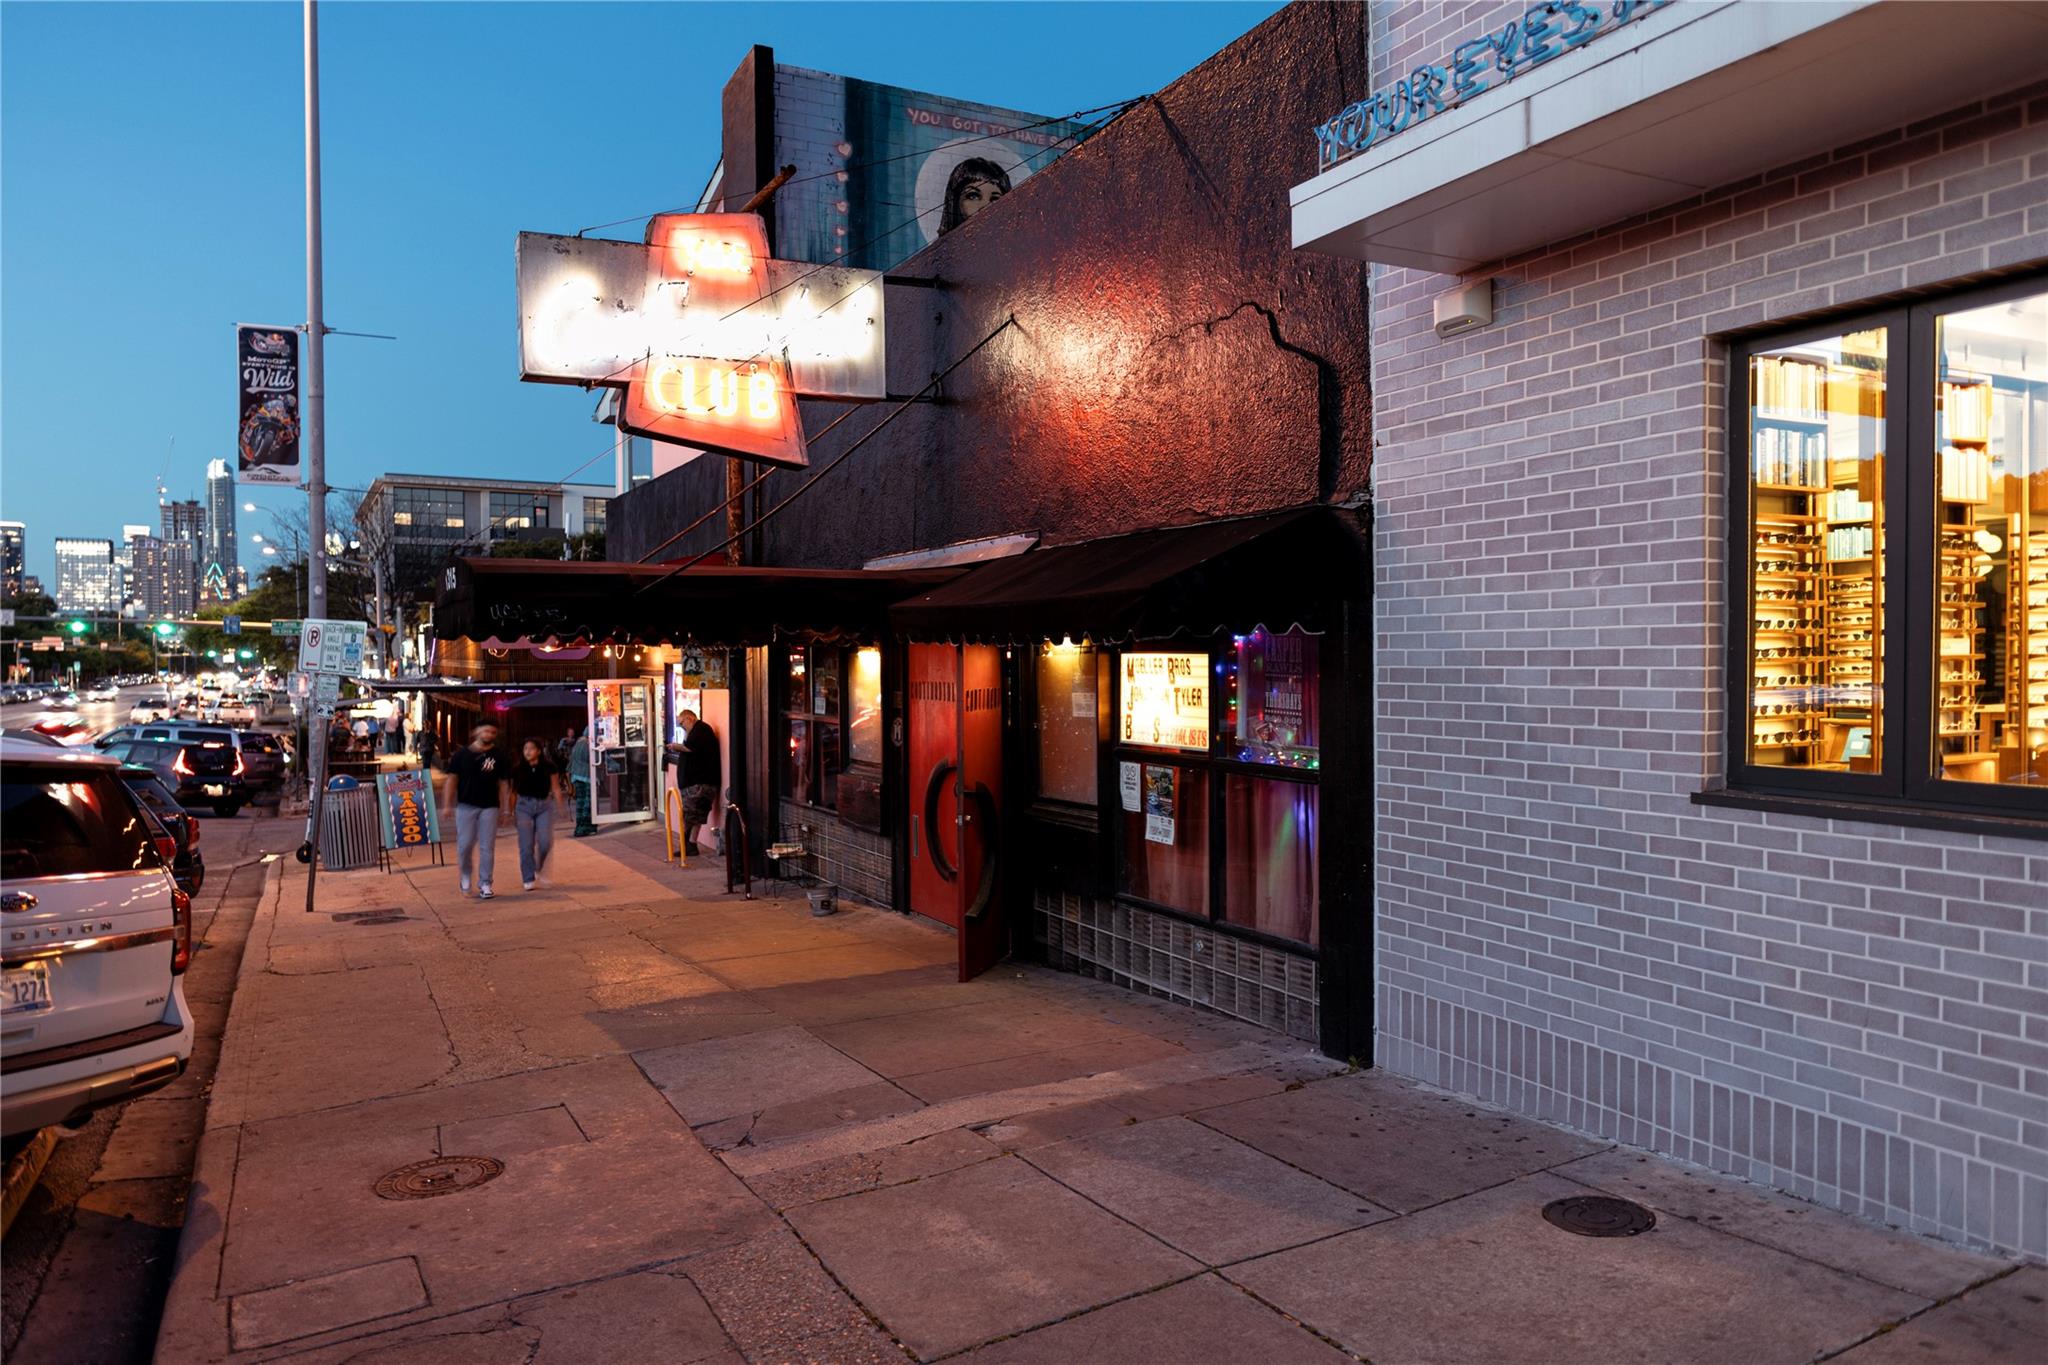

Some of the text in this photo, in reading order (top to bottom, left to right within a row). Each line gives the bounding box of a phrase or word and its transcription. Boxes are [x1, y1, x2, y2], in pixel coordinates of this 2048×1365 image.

[1314, 0, 1603, 163] YOUR EYES
[907, 107, 941, 125] YOU
[952, 117, 981, 133] GOT
[1014, 131, 1046, 146] HAVE
[243, 367, 295, 393] Wild
[651, 363, 778, 419] CLUB
[1167, 657, 1191, 684] BROS
[1174, 687, 1203, 715] TYLER
[1265, 691, 1302, 710] THURSDAYS
[398, 790, 422, 843] TATTOO
